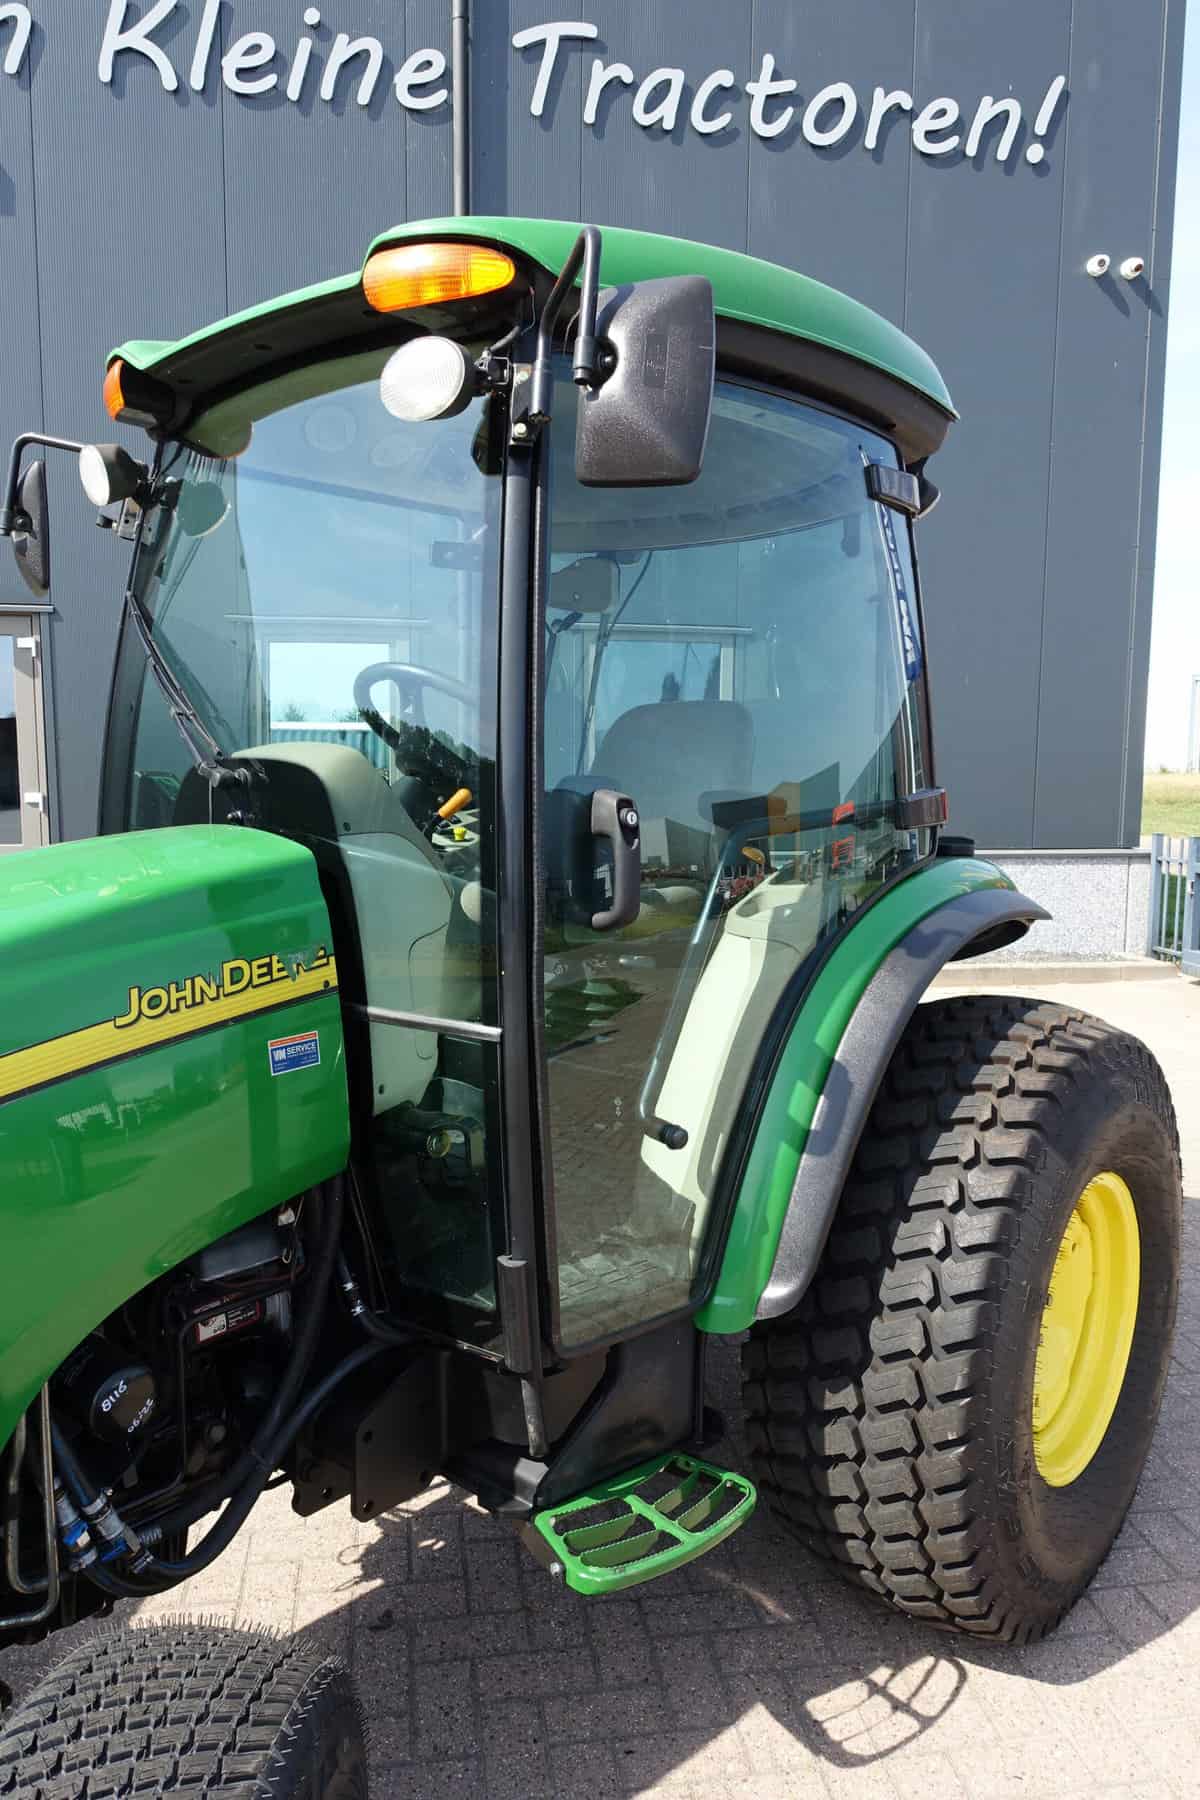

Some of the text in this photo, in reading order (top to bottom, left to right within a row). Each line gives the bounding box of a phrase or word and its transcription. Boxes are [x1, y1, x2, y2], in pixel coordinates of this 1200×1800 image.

[98, 0, 448, 110] Kleine
[512, 22, 1066, 164] Tractoren!
[114, 974, 221, 1028] JOHN
[286, 1042, 317, 1056] SERVICE
